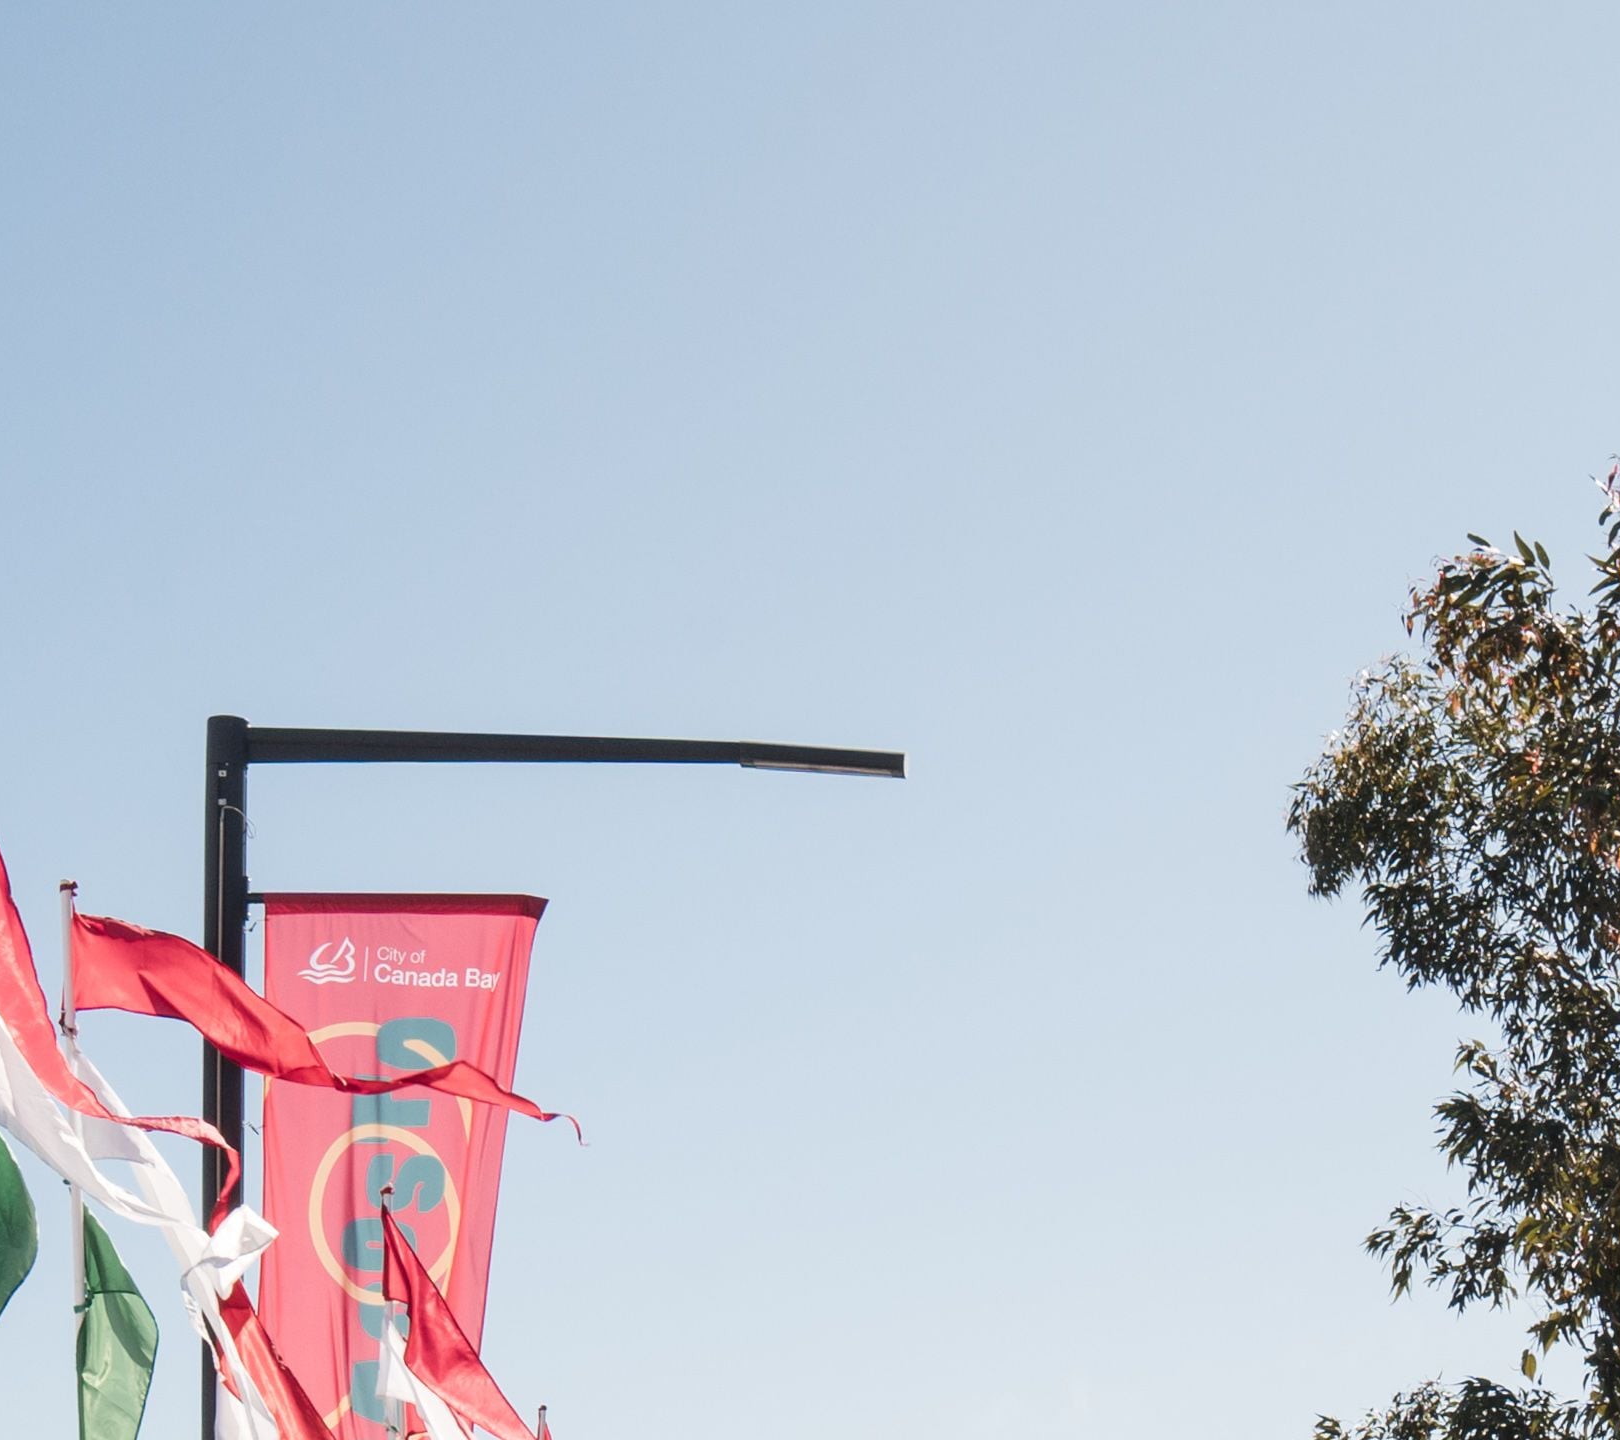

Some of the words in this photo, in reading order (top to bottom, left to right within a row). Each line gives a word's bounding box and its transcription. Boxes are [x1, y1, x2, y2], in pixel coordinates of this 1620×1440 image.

[376, 946, 407, 964] City
[410, 949, 426, 964] of
[374, 964, 458, 988] Canada
[464, 967, 500, 992] Bay
